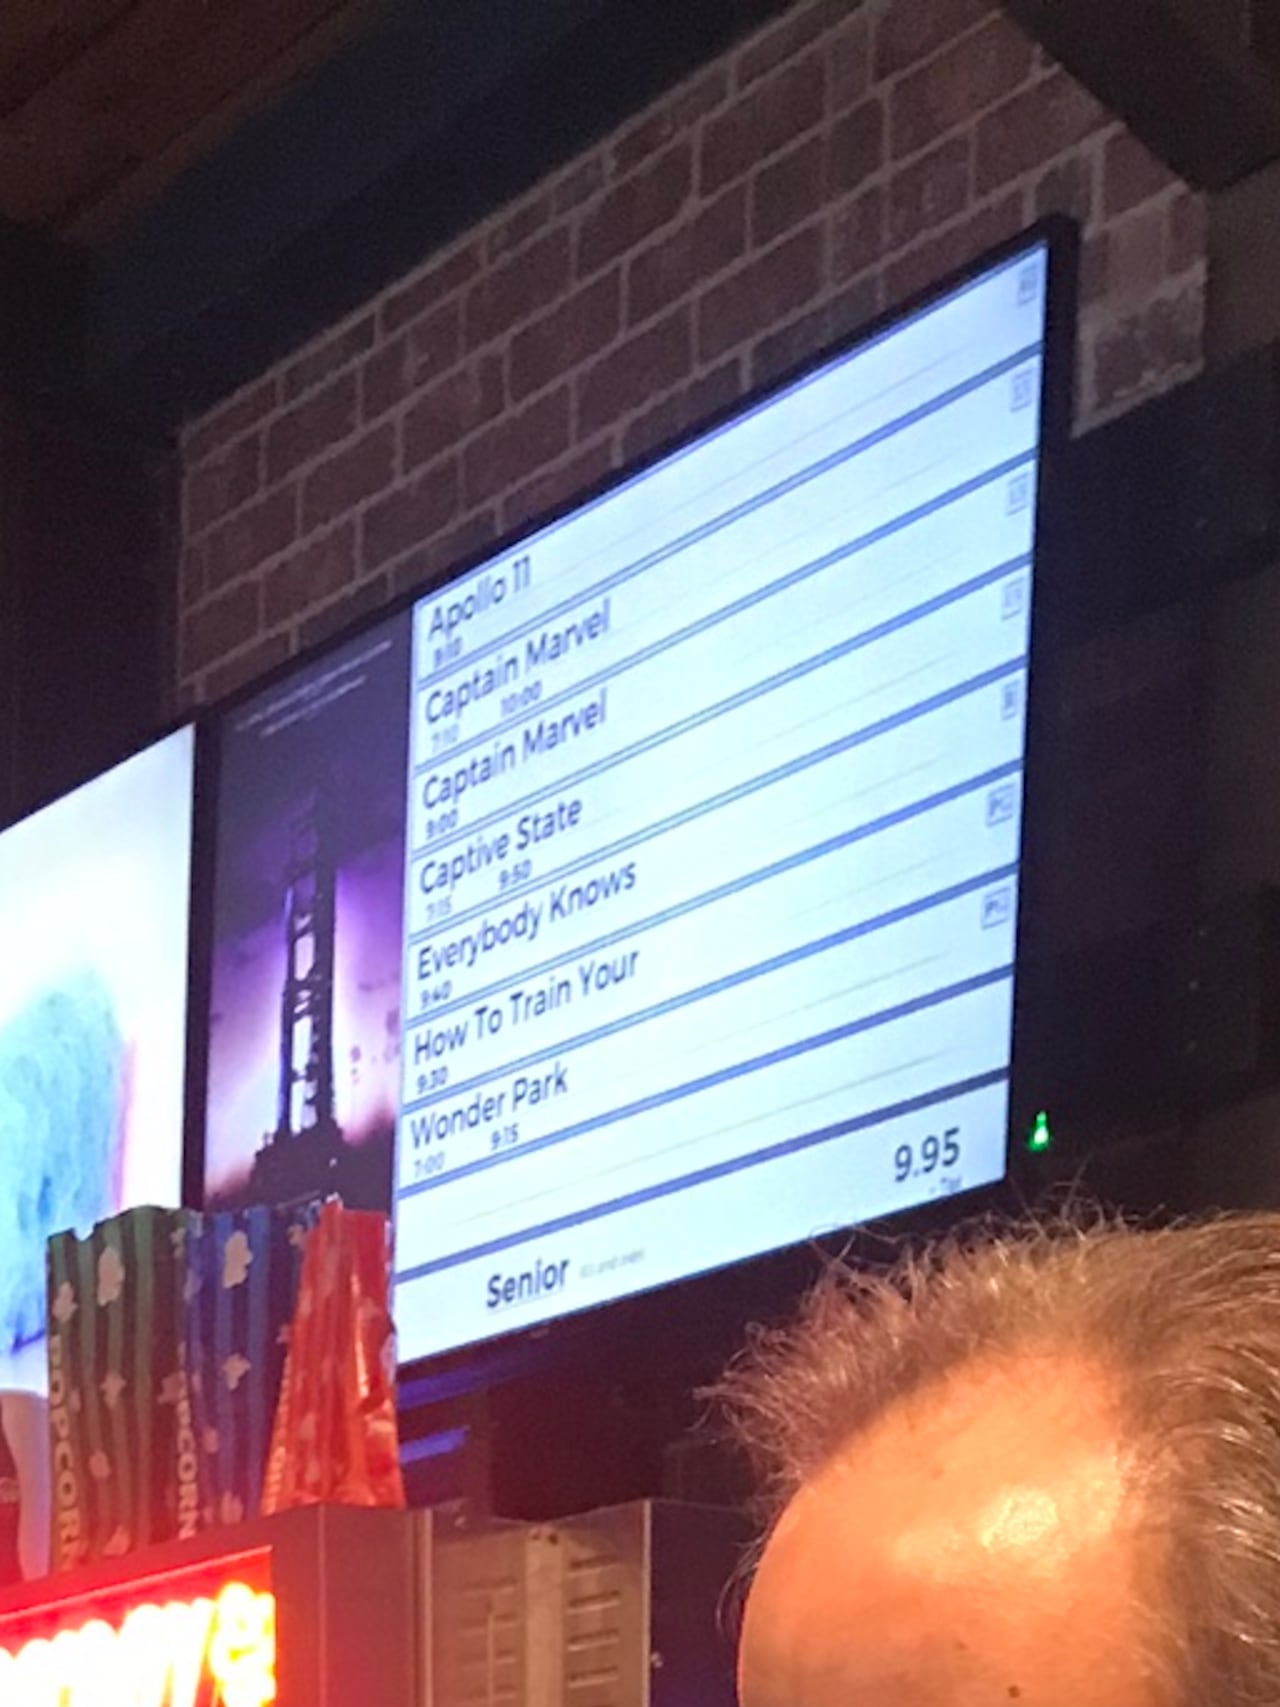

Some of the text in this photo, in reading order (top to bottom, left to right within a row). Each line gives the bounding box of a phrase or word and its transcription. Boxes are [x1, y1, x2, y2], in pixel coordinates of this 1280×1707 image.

[428, 556, 530, 642] Apollo 11
[426, 654, 518, 723] Captain
[524, 597, 611, 675] Marvel
[422, 687, 607, 809] Captain Marvel
[420, 800, 582, 894] Captive State
[417, 862, 637, 981] Everybody Knows
[414, 950, 640, 1065] How To Train Your
[410, 1061, 569, 1150] Wonder Park
[894, 1127, 961, 1183] 9.95
[486, 1258, 571, 1309] Senior
